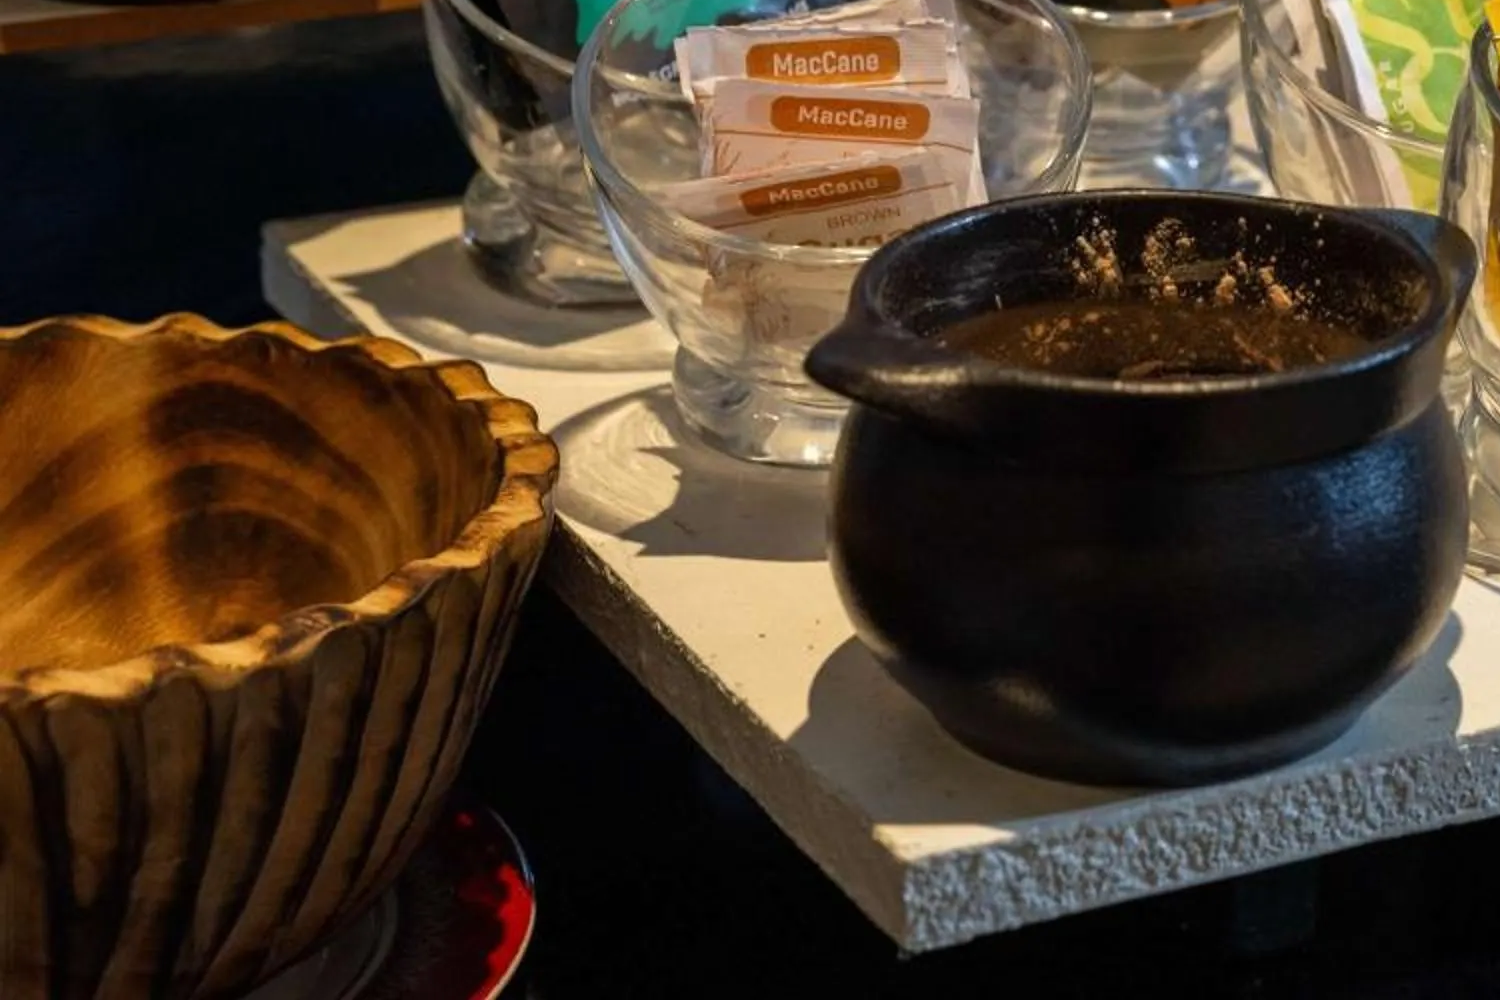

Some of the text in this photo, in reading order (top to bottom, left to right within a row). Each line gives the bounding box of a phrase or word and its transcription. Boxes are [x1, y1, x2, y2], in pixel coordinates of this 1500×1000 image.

[772, 49, 880, 78] MacCane
[798, 104, 909, 131] MacCane
[767, 174, 880, 205] MacCane
[825, 206, 902, 230] BROWN
